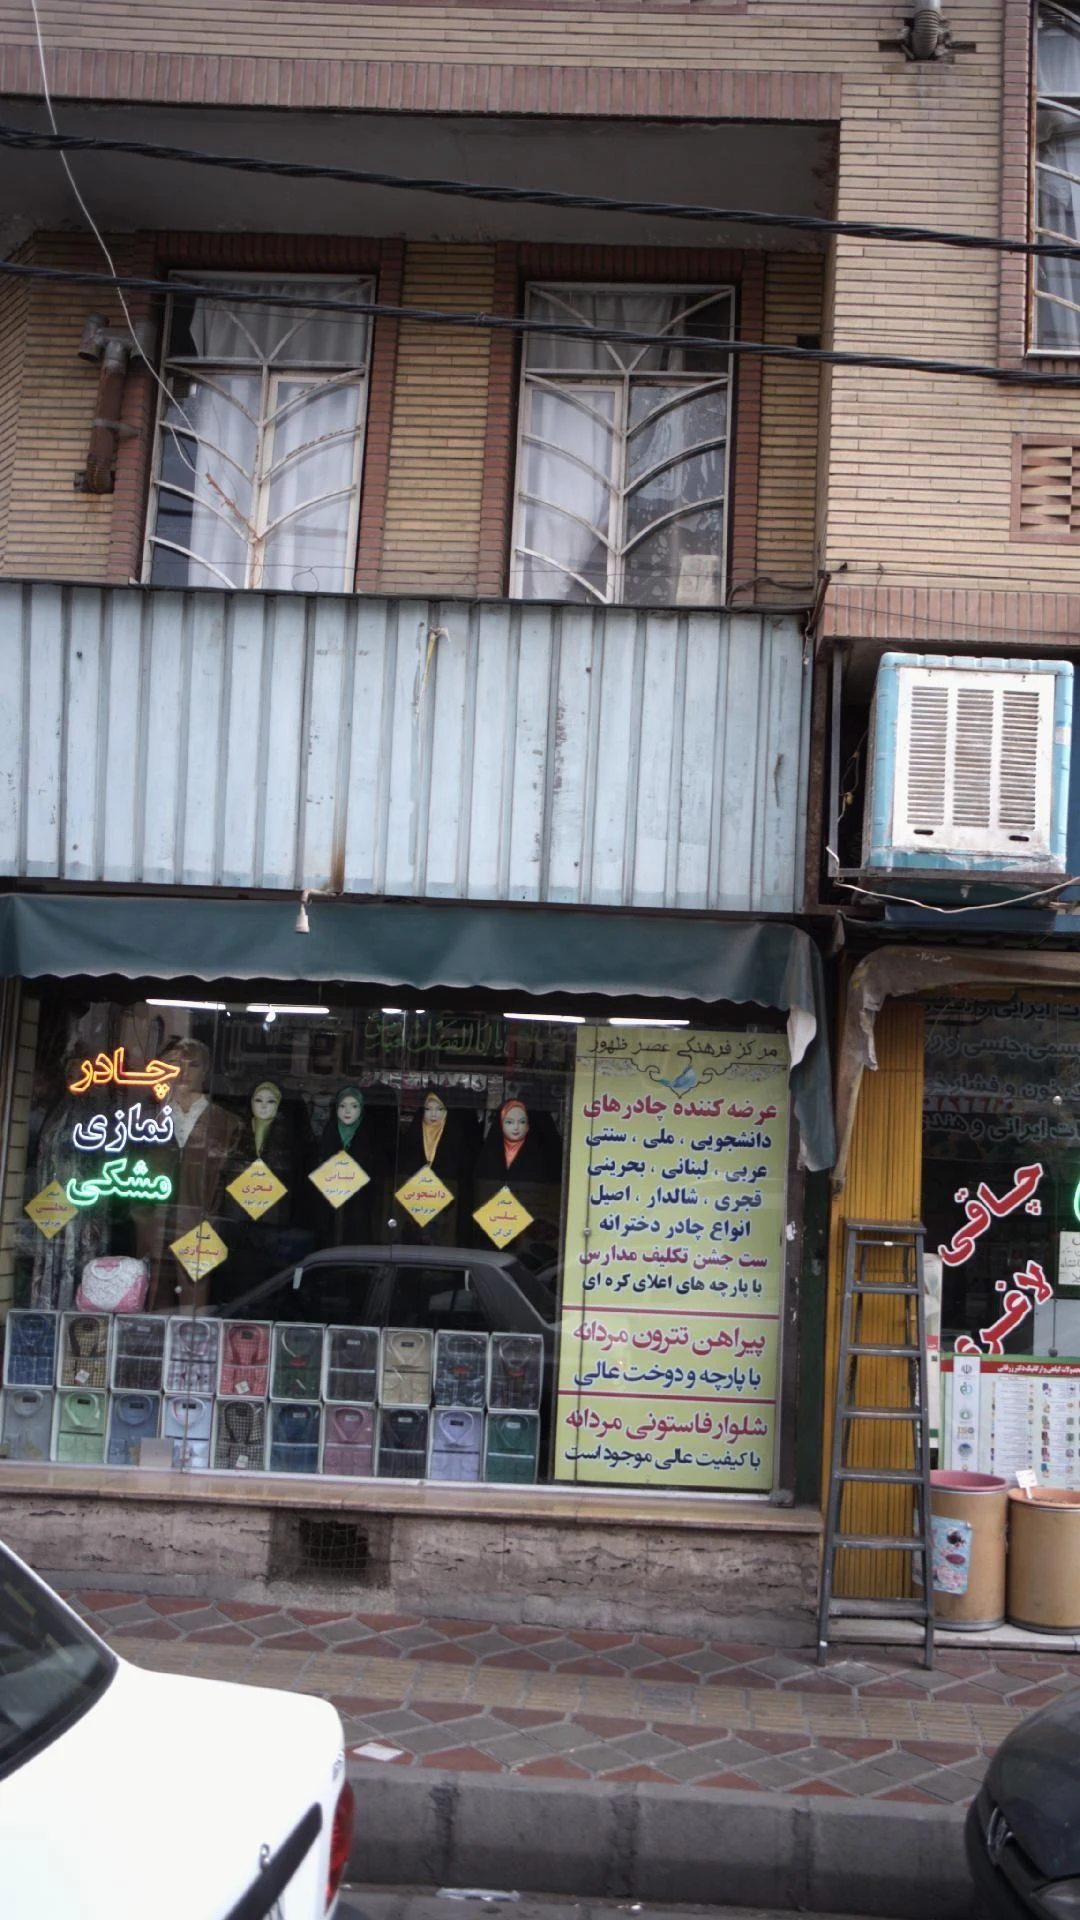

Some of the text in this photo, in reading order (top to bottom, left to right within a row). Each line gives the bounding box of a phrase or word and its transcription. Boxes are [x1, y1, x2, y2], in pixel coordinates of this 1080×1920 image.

[587, 1036, 629, 1054] ظهور
[631, 1041, 671, 1055] عصر
[736, 1040, 778, 1060] مرکز
[69, 1046, 181, 1100] چادر
[673, 1099, 725, 1118] کننده
[727, 1101, 778, 1126] عرضه
[72, 1102, 175, 1151] نمازی
[586, 1128, 772, 1152] دانشجویی ملی سنتی
[65, 1158, 173, 1206] مشکی
[586, 1157, 768, 1184] عربی لبنانی بحرینی
[590, 1184, 763, 1213] قجری شالدار اصیل
[599, 1214, 752, 1242] انواع چادر دخترانه
[938, 1163, 1043, 1266] چاقی
[579, 1244, 768, 1270] ست جشن تکلیف مدارس
[581, 1272, 763, 1298] با پارچه های اعلای کره ای
[573, 1320, 766, 1358] پیراهن تترون مردانه
[574, 1360, 762, 1392] با پارچه و دوخت عالی
[565, 1408, 769, 1444] شلوار فاستونی مردانه
[564, 1444, 761, 1470] با کیفیت عالی موجود است
